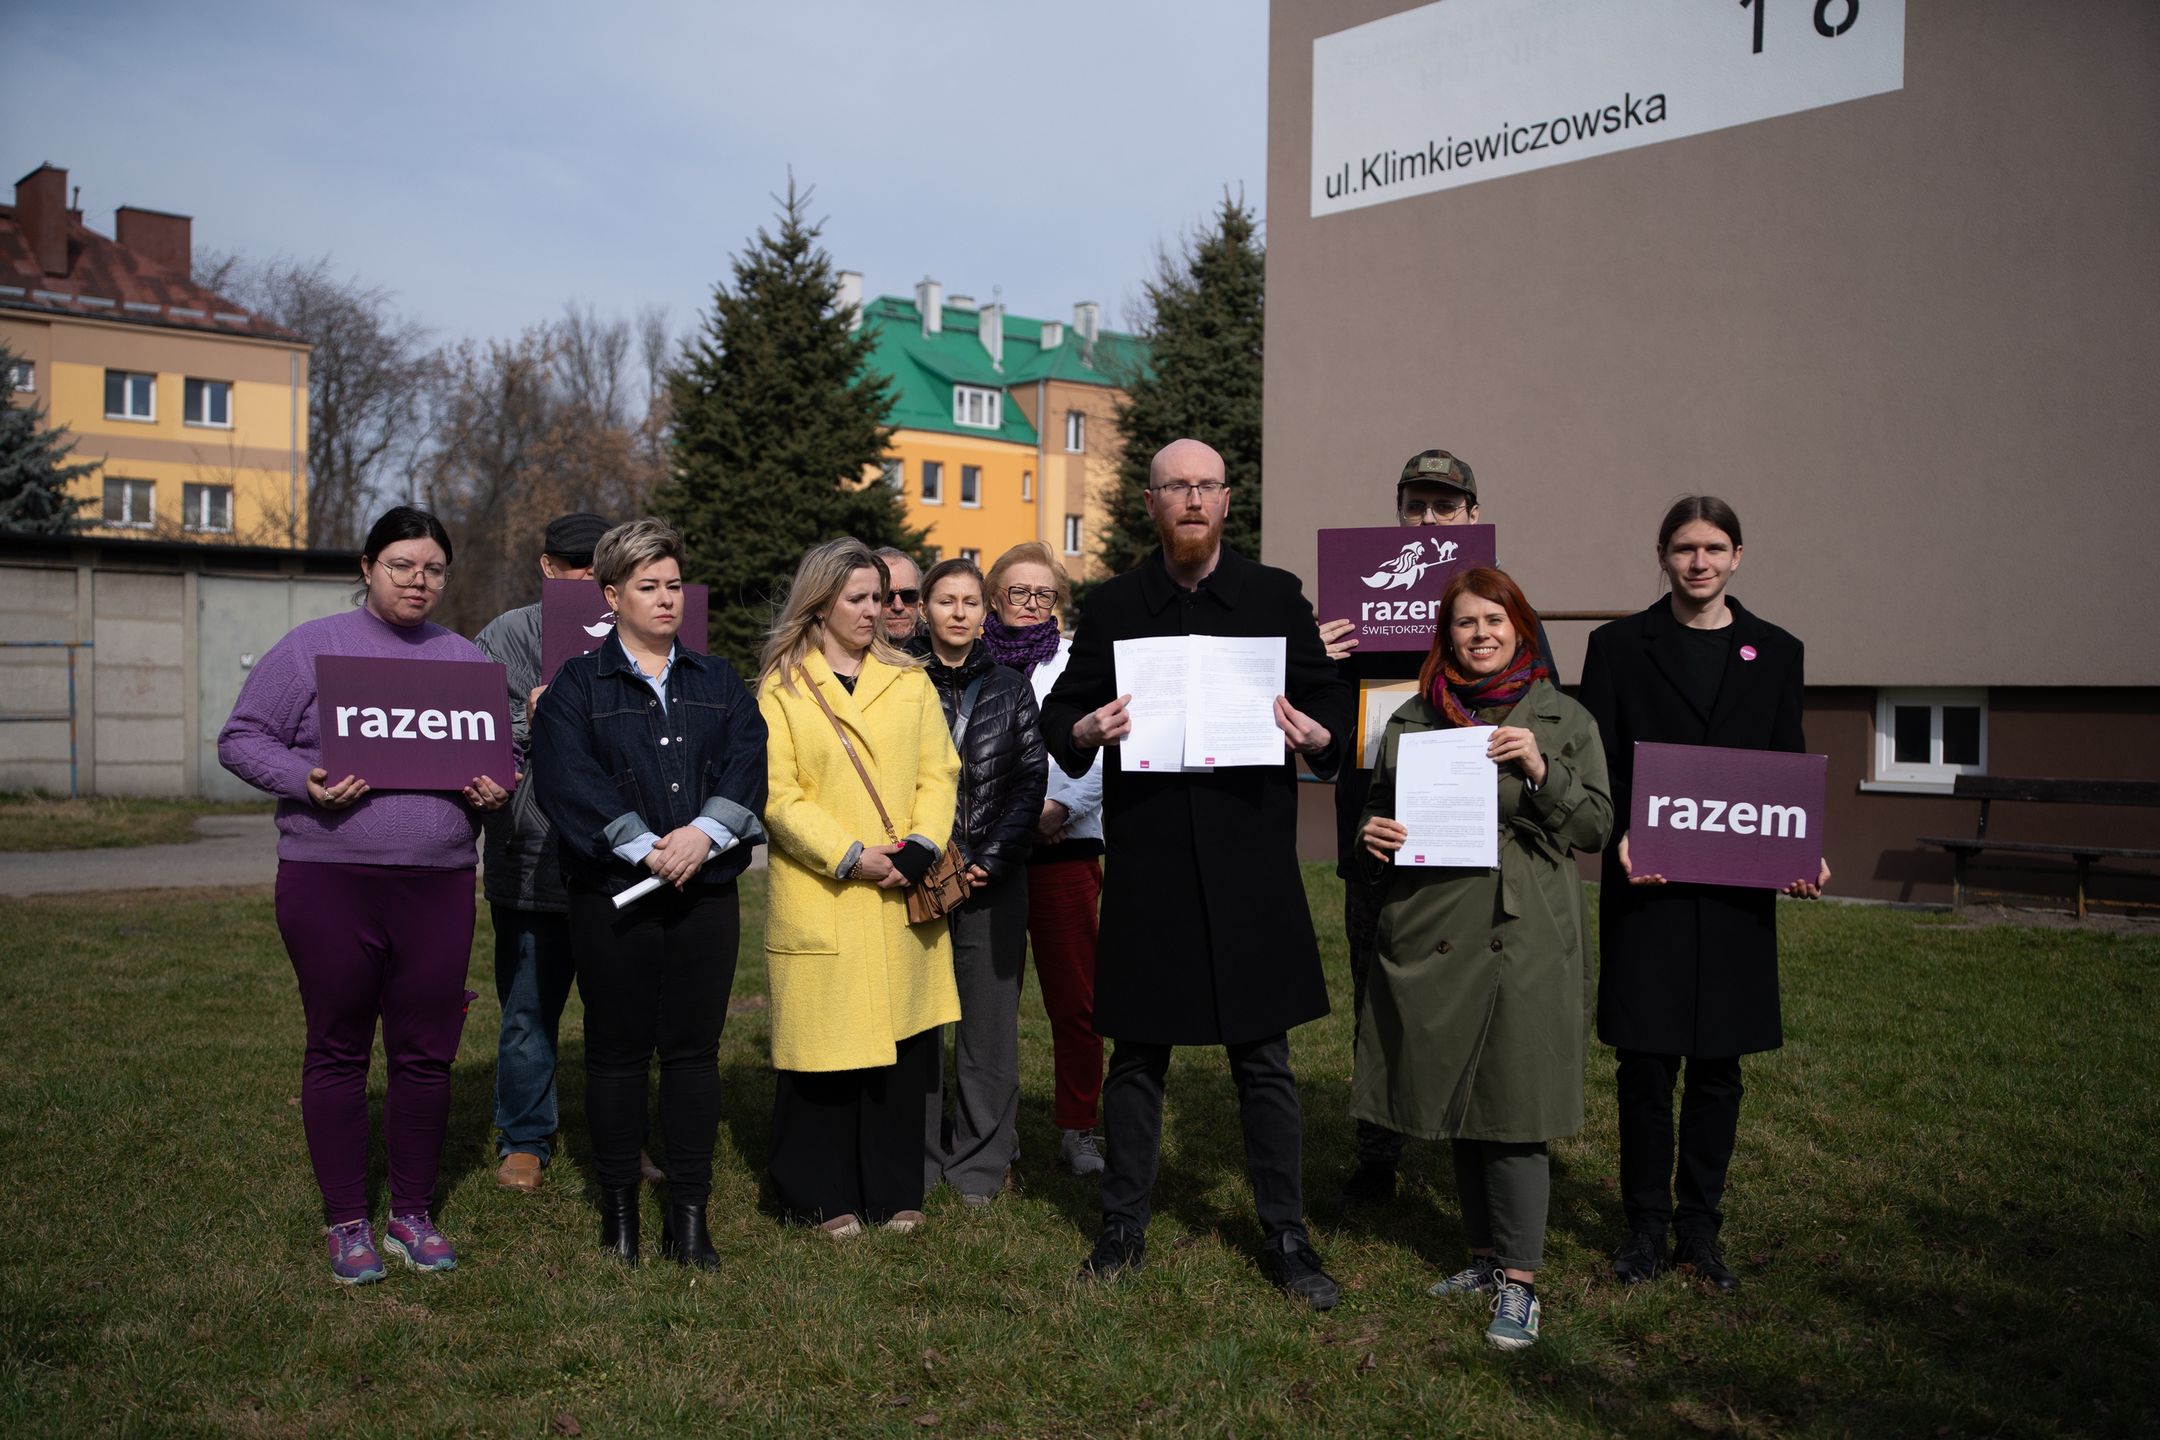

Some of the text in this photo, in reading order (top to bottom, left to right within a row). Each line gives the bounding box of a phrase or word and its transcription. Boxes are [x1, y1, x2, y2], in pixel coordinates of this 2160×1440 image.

[1361, 624, 1437, 637] ŚWIĘTOKRZYS
[336, 706, 496, 741] razem
[1647, 795, 1807, 839] razem
